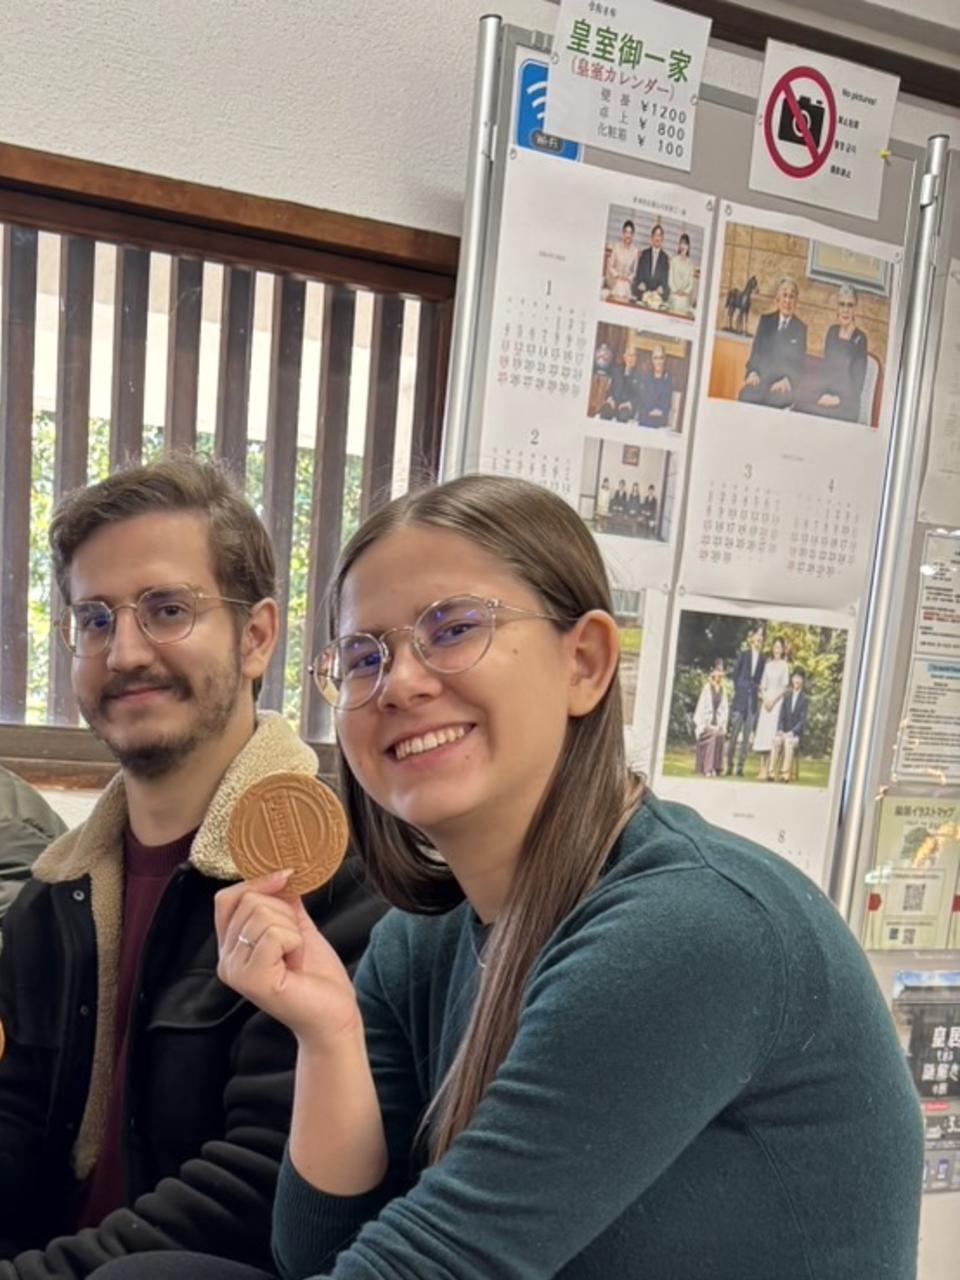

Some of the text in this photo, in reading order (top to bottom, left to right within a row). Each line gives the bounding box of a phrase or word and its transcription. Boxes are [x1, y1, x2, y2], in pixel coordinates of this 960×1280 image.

[566, 18, 692, 83] 皇室御一家
[657, 122, 685, 141] 800
[657, 139, 684, 158] 100
[530, 428, 540, 445] 2
[744, 464, 753, 479] 3
